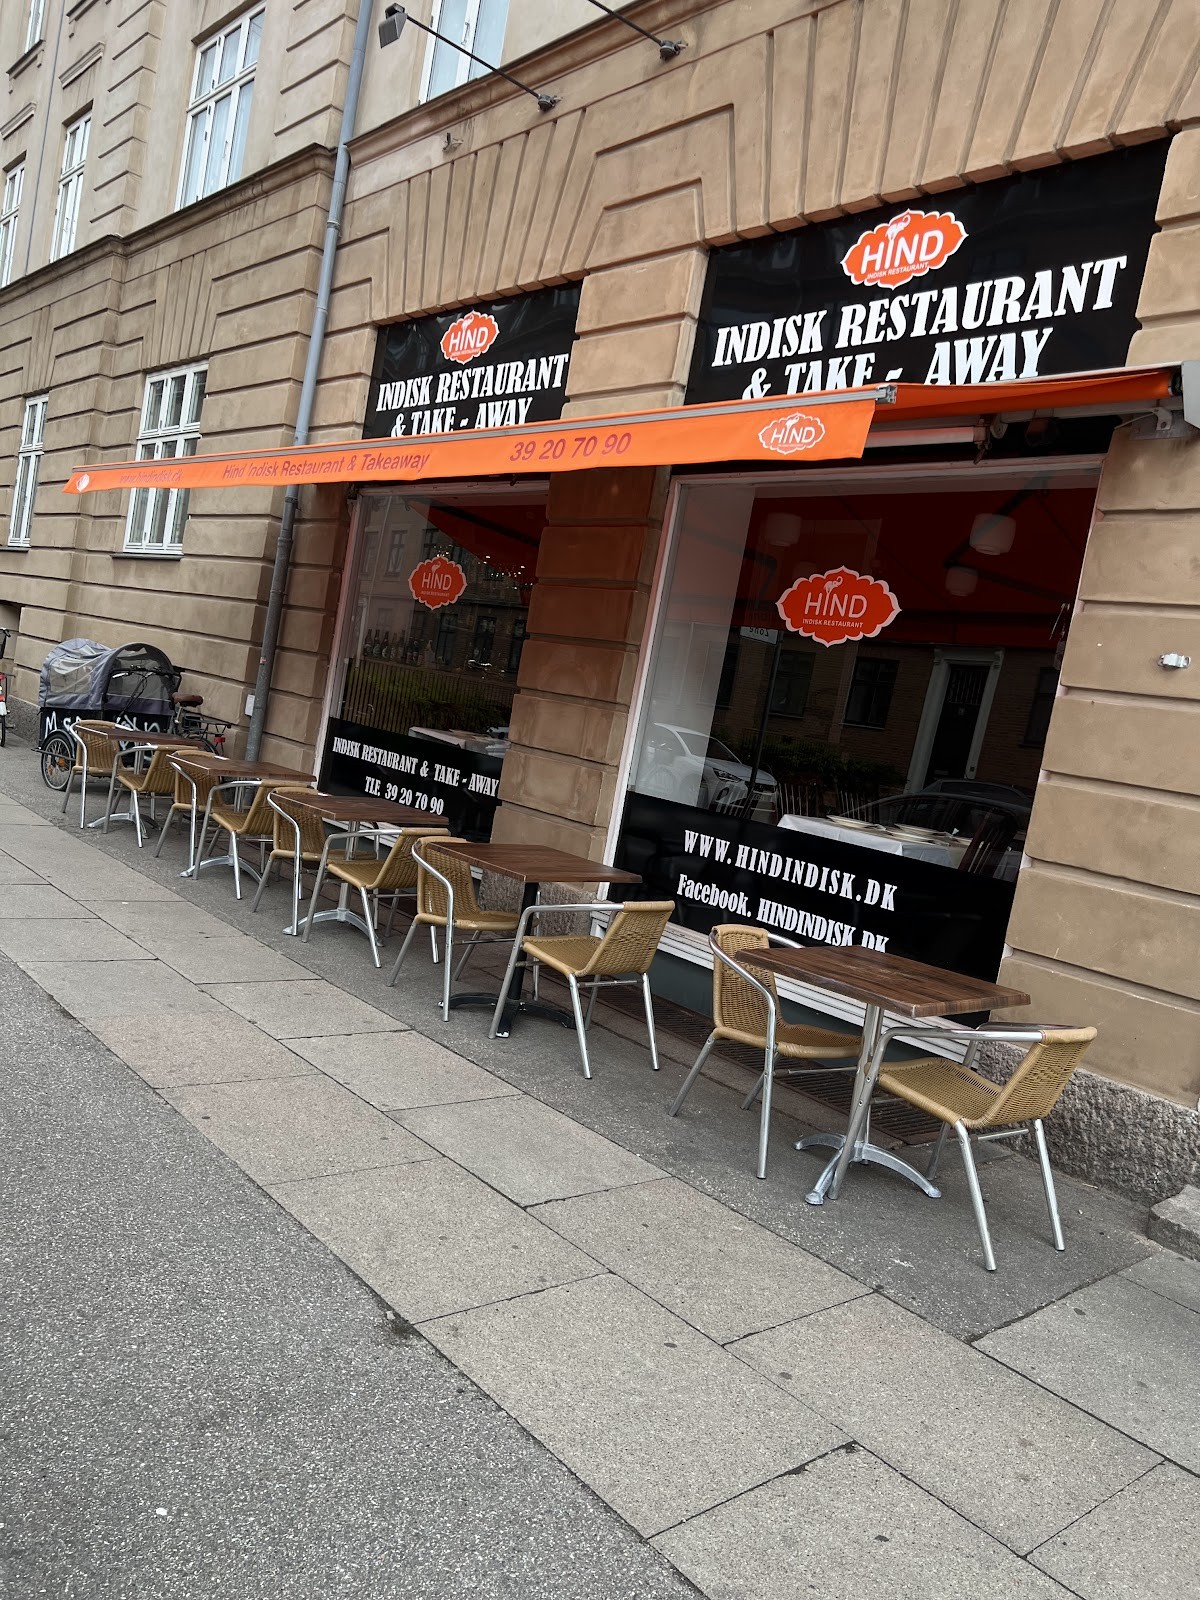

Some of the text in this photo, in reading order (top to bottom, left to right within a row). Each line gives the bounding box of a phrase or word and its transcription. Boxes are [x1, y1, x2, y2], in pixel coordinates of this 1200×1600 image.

[861, 229, 944, 275] HIND
[867, 261, 929, 280] INDISK RESTAURANT
[711, 255, 1127, 367] INDISK RESTAURANT
[448, 326, 489, 353] HIND
[742, 367, 771, 400] &
[784, 352, 876, 396] TAKE
[923, 327, 1053, 386] AWAY
[376, 353, 569, 412] INDISK RESTAURANT
[391, 413, 406, 438] &
[411, 406, 456, 437] TAKE
[474, 397, 533, 430] AWAY
[509, 432, 632, 462] 39 20 70 90
[770, 426, 816, 444] HIND
[222, 452, 430, 480] Hind Indisk Restaurant & Takeaway
[421, 571, 452, 591] HIND
[804, 591, 868, 619] HIND
[802, 618, 864, 629] INDISK RESTAURANT
[332, 736, 361, 759] INDISK
[361, 743, 419, 775] RESTAURANT
[420, 760, 429, 778] &
[434, 763, 461, 787] TAKE
[468, 772, 499, 797] AWAY
[385, 782, 398, 801] 39
[398, 787, 413, 806] 20
[415, 791, 428, 811] 70
[429, 796, 444, 815] 90
[676, 873, 752, 918] Facebook.
